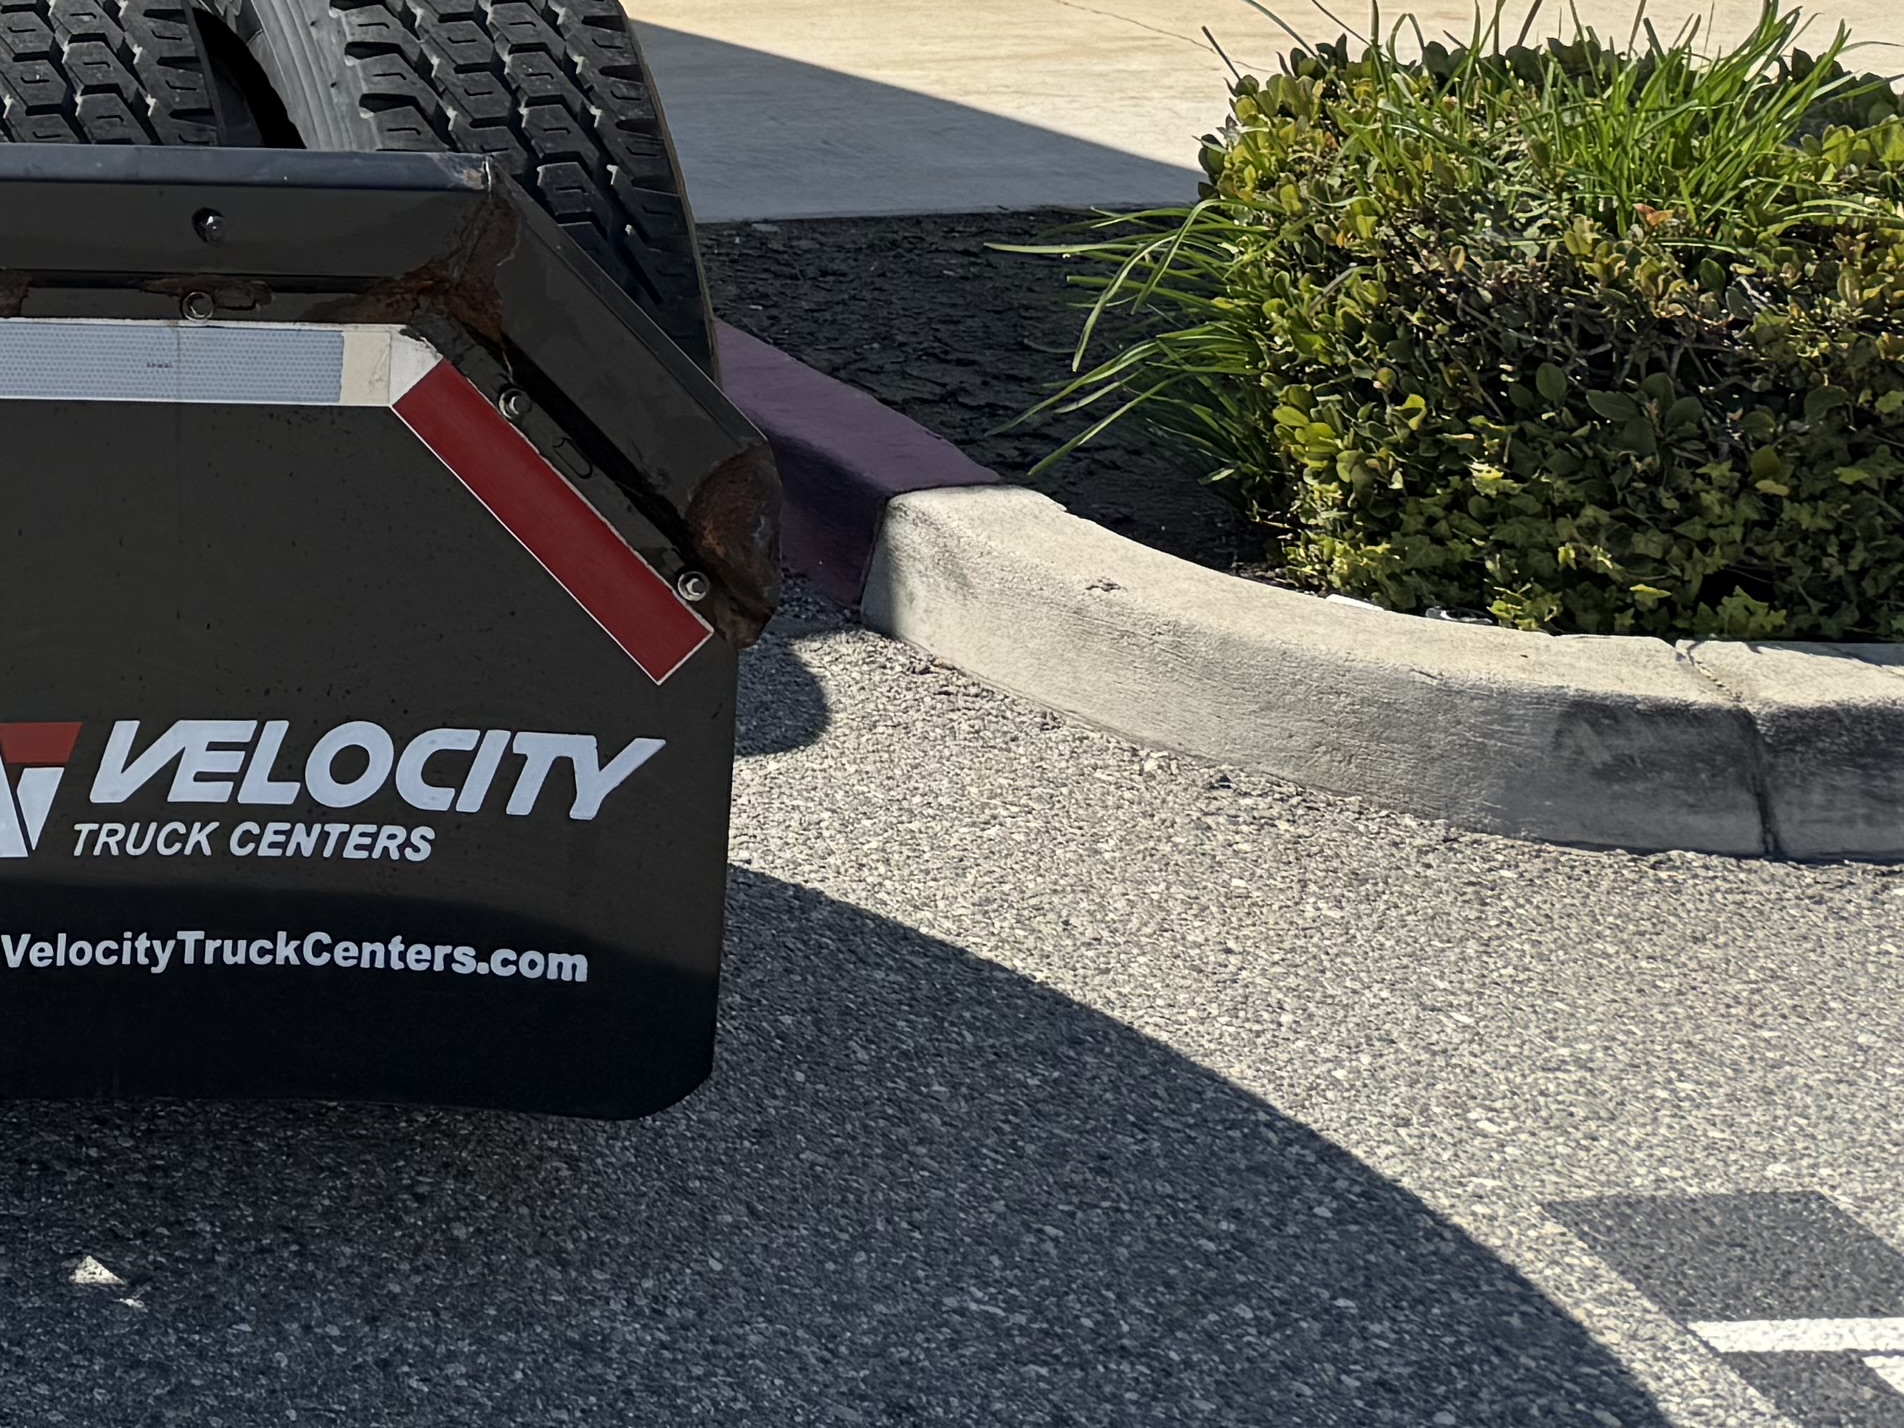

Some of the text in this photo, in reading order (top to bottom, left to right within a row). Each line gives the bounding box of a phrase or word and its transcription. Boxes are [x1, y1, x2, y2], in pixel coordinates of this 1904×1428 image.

[90, 720, 666, 821] VELOCITY
[73, 821, 436, 862] TRUCK CENTERS
[0, 930, 588, 982] VelocityTruckCenters.com
